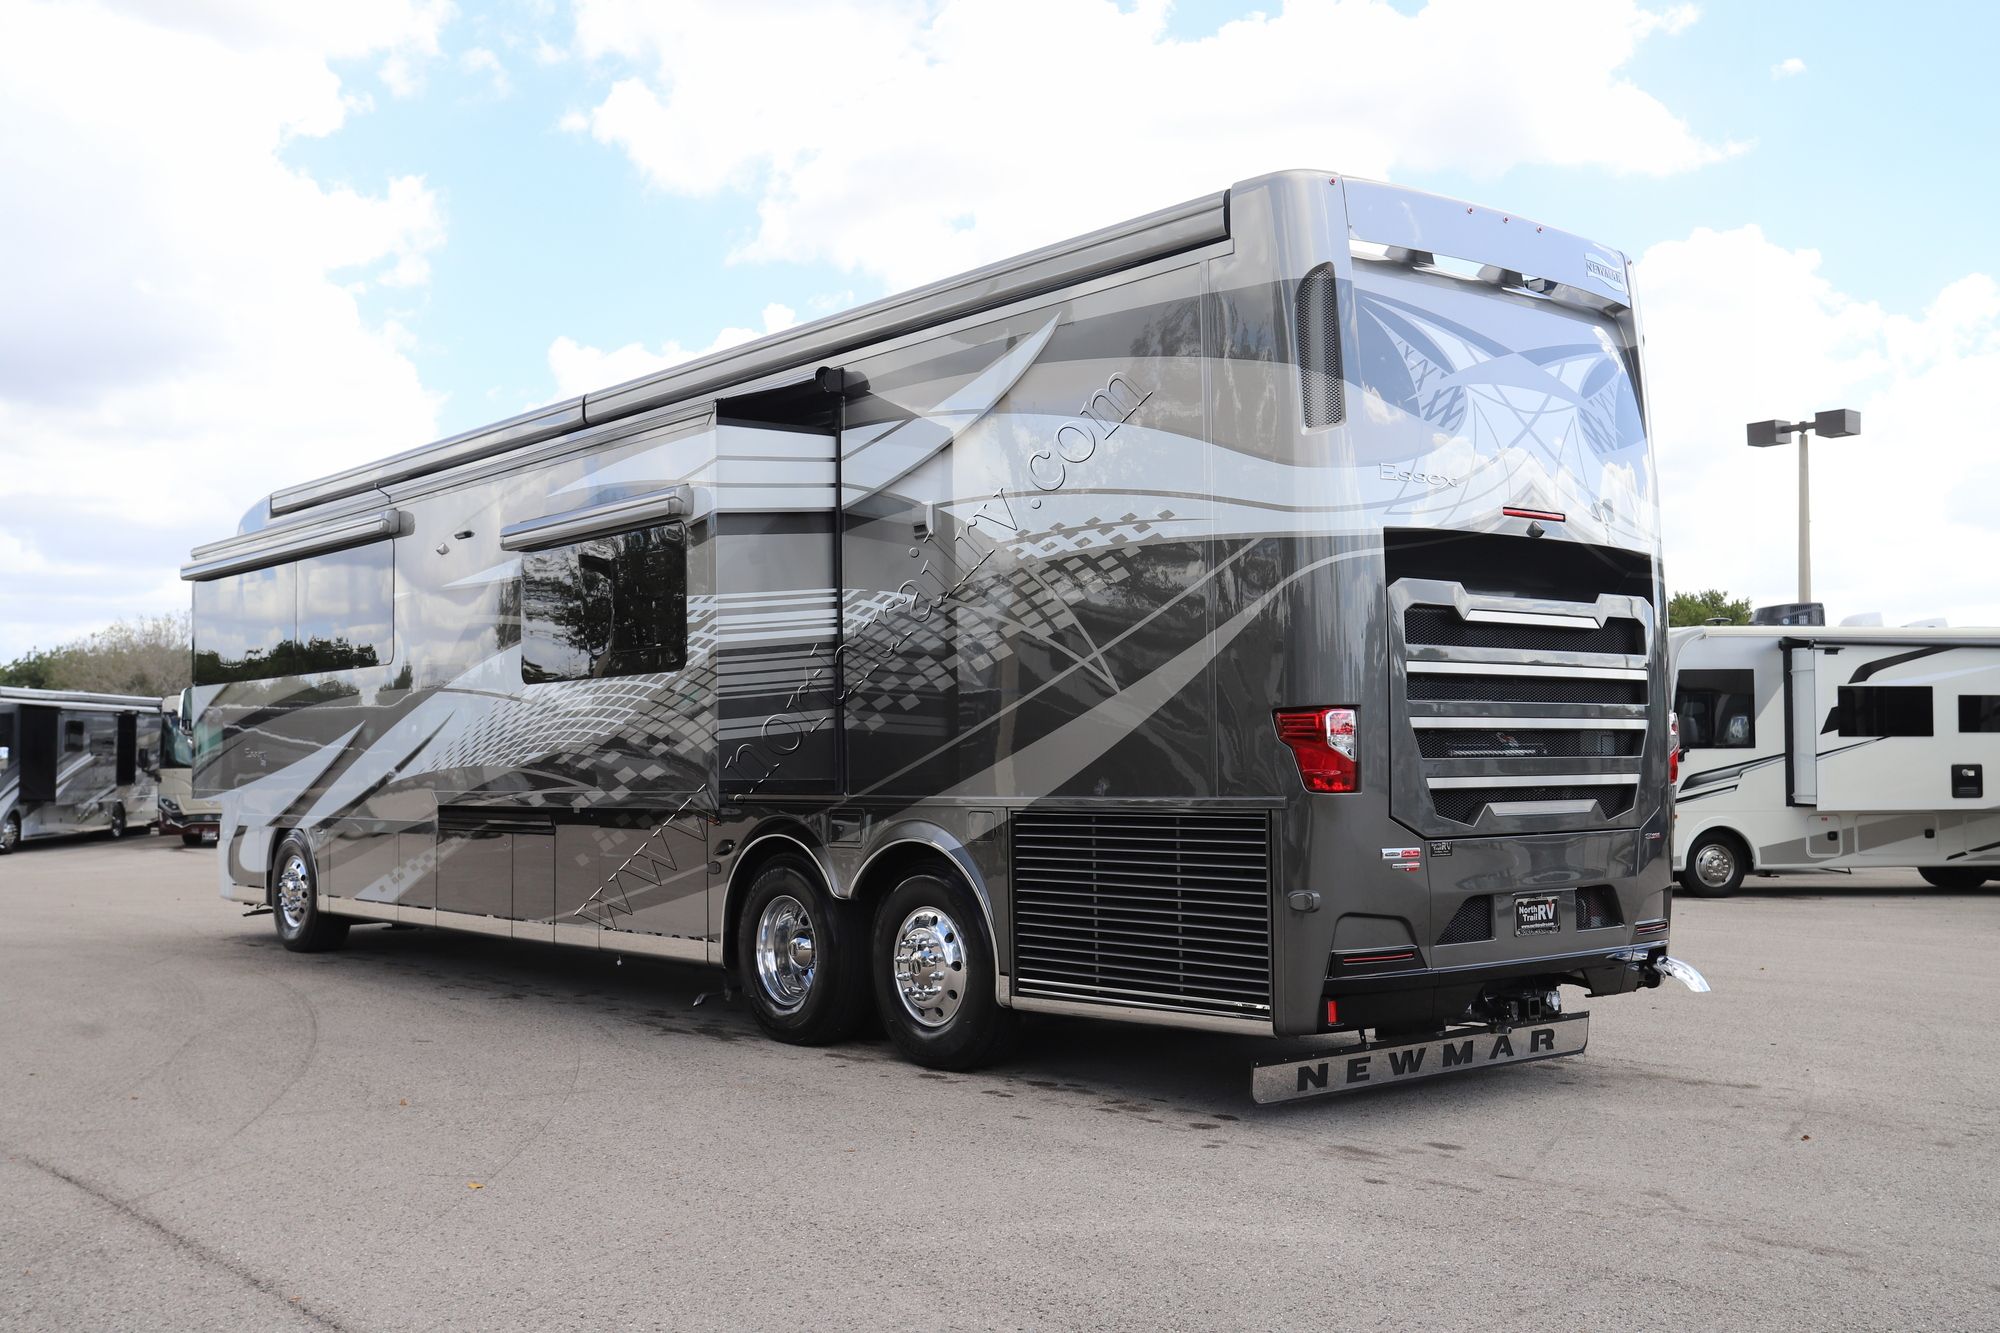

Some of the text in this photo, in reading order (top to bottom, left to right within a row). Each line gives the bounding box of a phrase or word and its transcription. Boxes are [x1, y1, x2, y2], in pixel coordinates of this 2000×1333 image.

[1379, 463, 1457, 488] Essex
[1518, 905, 1538, 914] North
[1522, 913, 1538, 922] Trail
[1537, 903, 1555, 921] RV
[1296, 1028, 1556, 1092] NEWMAR
